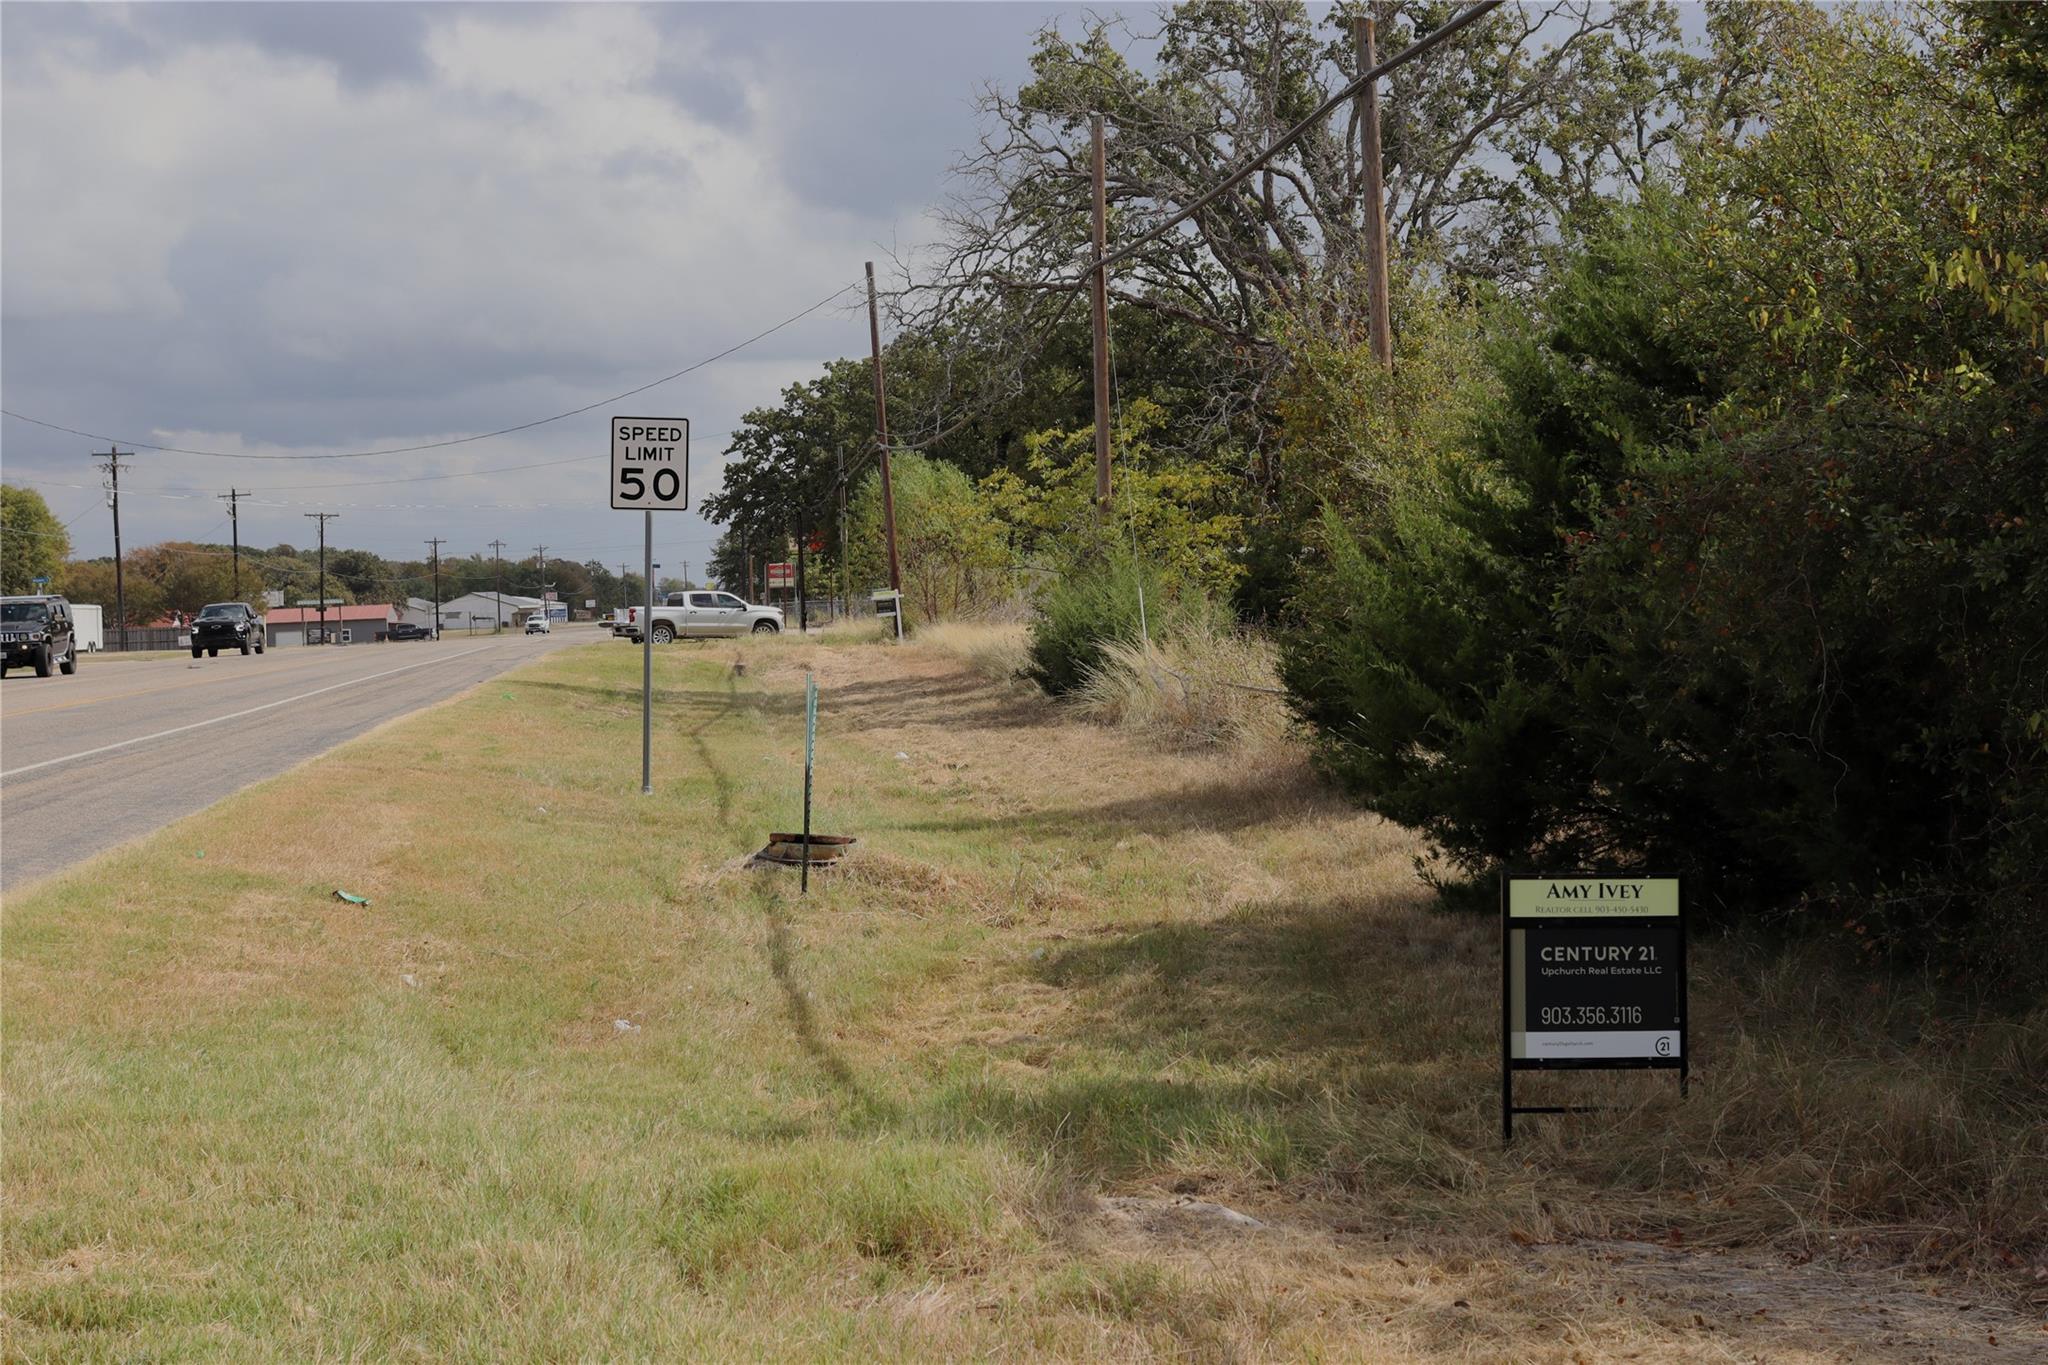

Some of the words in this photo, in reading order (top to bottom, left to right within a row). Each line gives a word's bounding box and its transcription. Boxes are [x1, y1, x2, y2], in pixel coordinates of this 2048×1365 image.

[619, 426, 682, 442] SPEED
[625, 446, 675, 461] LIMIT
[619, 467, 680, 502] 50
[1540, 946, 1633, 961] CENTURY
[1638, 946, 1655, 961] 21
[1541, 967, 1586, 977] Upchurch
[1588, 967, 1608, 975] Real
[1610, 966, 1642, 975] Estate
[1643, 966, 1662, 974] LLC
[1541, 1006, 1642, 1025] 903.356.3116
